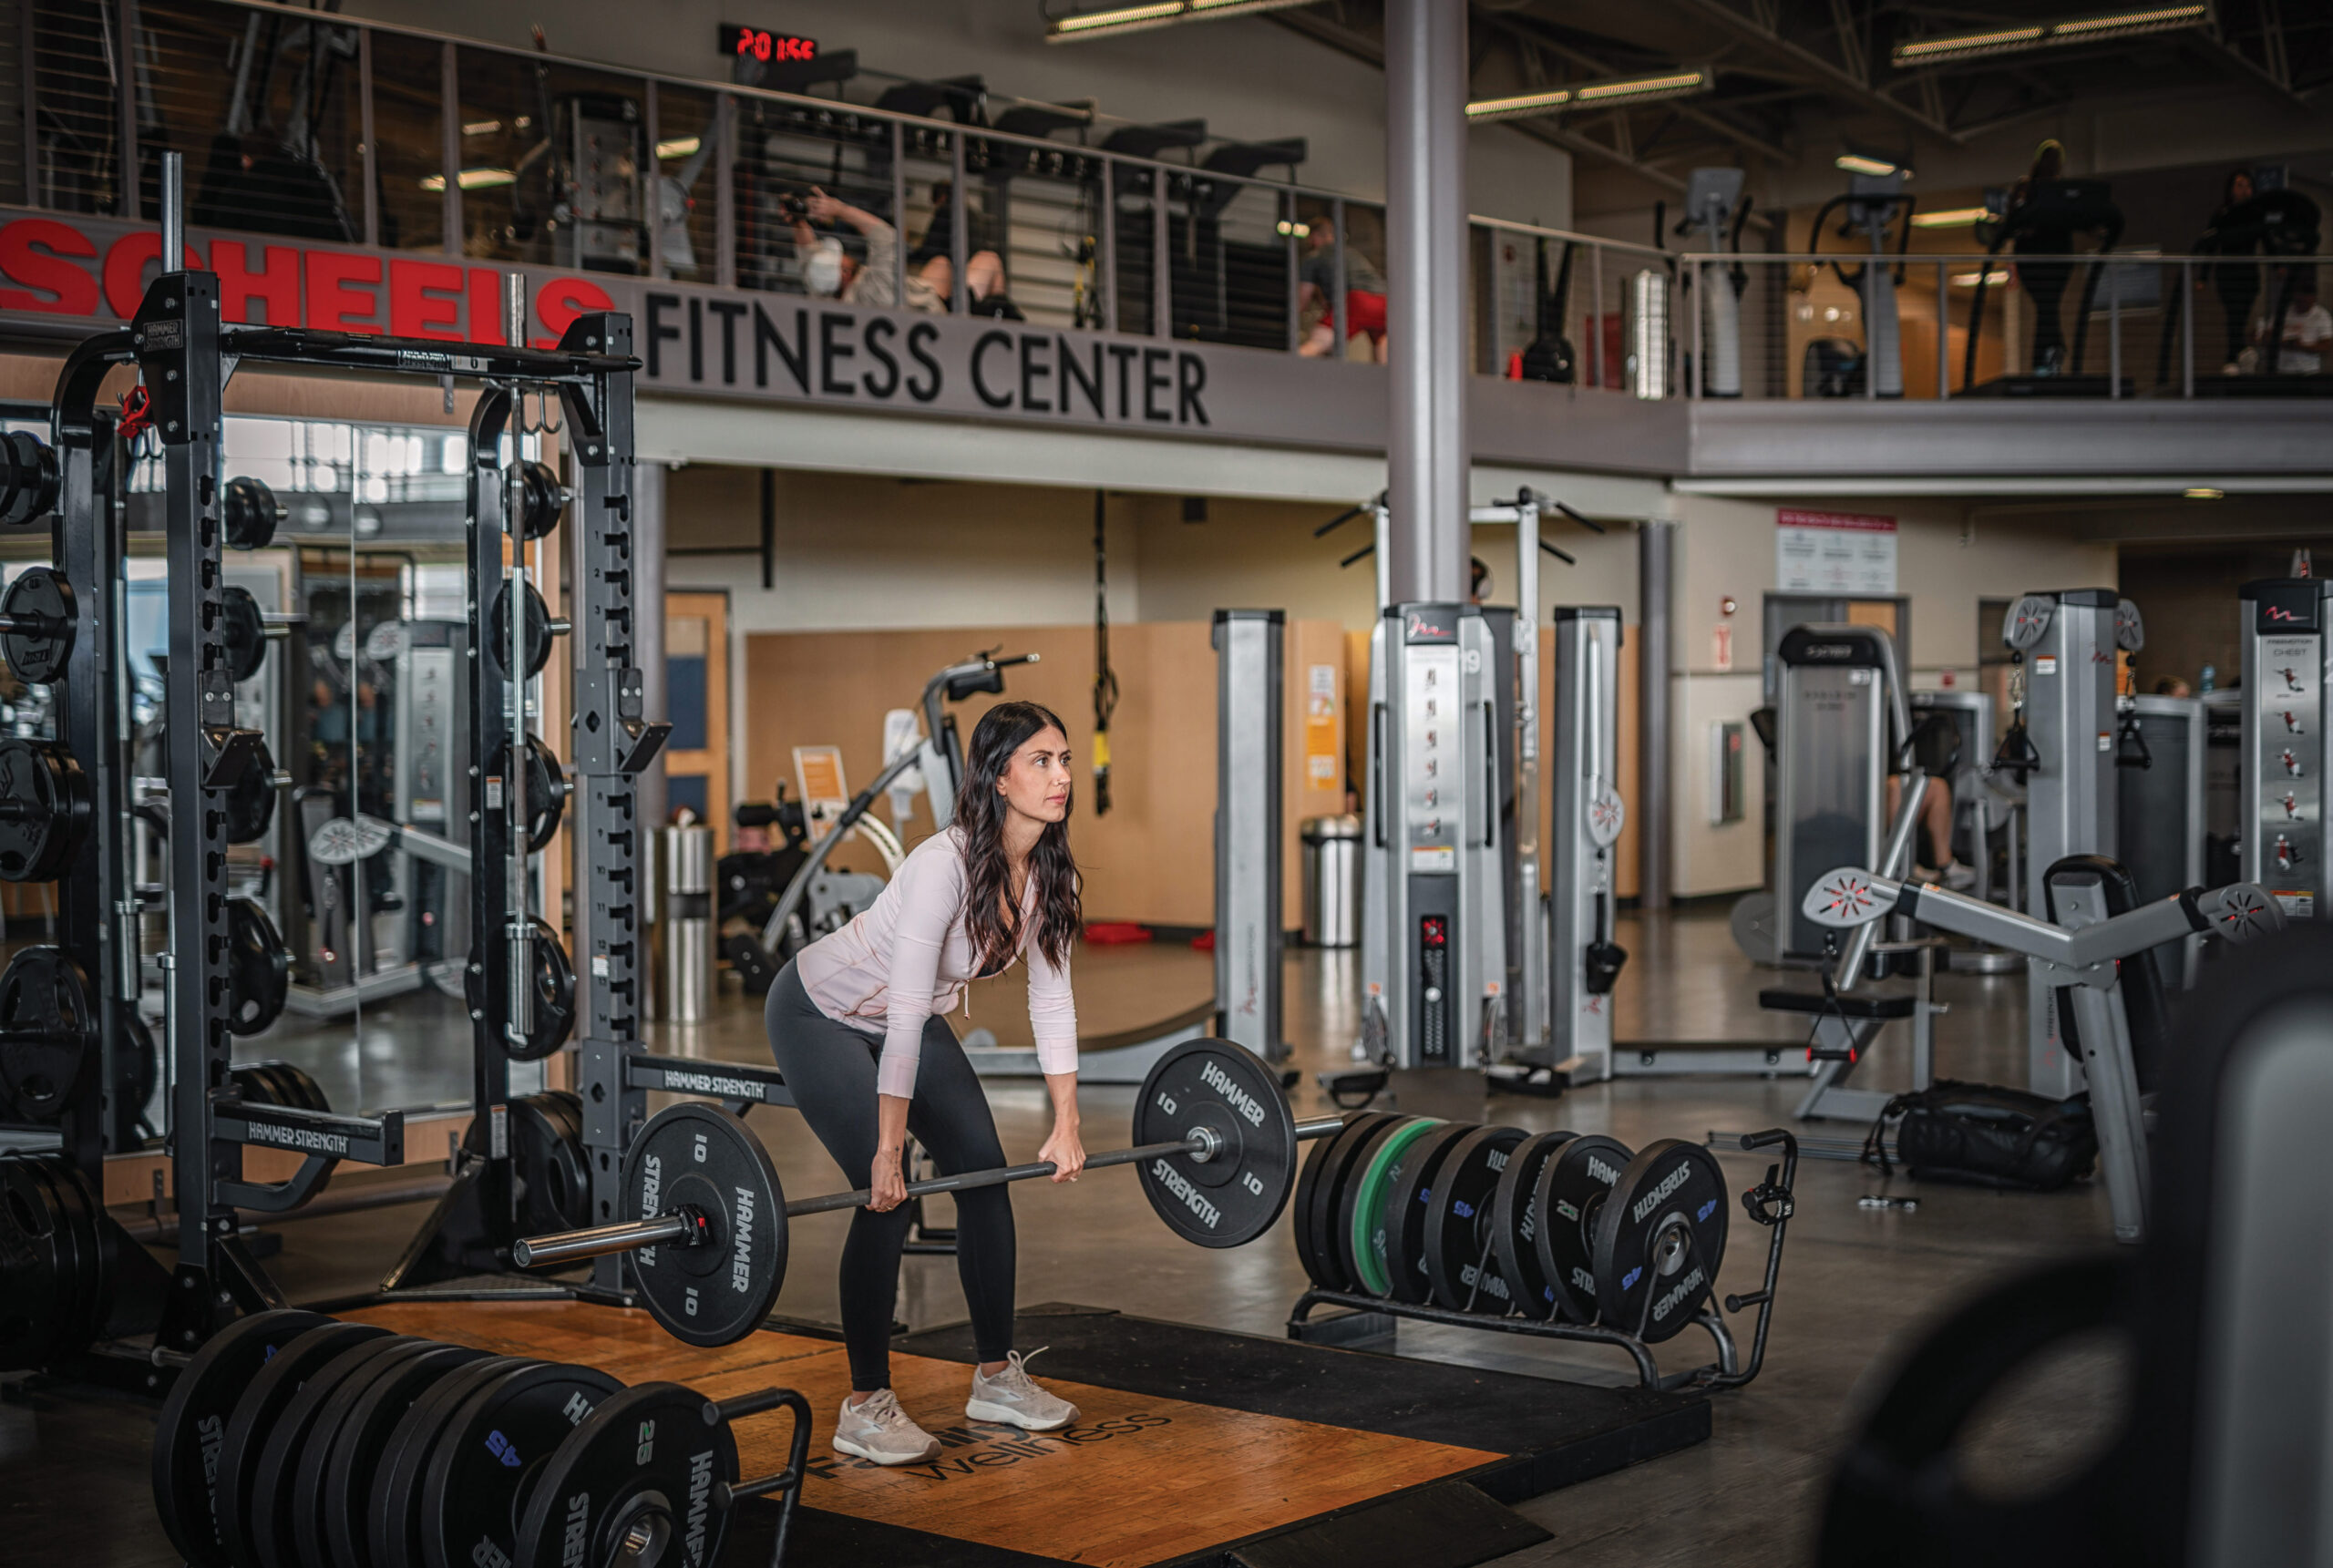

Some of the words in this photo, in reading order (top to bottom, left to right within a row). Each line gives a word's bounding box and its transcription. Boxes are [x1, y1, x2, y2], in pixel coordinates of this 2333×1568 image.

[147, 322, 179, 336] HAMMER
[646, 292, 943, 402] FITNESS
[970, 329, 1211, 425] CENTER
[664, 1070, 711, 1091] HAMMER
[712, 1076, 765, 1099] STRENGTH
[1199, 1061, 1266, 1128] HAMMER
[1156, 1091, 1177, 1116] 10
[249, 1121, 294, 1144] HAMMER
[295, 1129, 348, 1153] STRENGTH
[694, 1133, 708, 1163] 10
[1152, 1158, 1221, 1229] STRENGTH
[1242, 1171, 1264, 1195] 10
[1633, 1160, 1691, 1224] STRENGTH
[640, 1153, 661, 1267] STRENH
[1454, 1200, 1475, 1218] 45
[1557, 1199, 1579, 1222] 25
[1697, 1198, 1718, 1223] 45
[732, 1185, 755, 1294] HAMMER
[1621, 1266, 1642, 1291] 45
[1652, 1267, 1704, 1321] HAMMER
[684, 1286, 699, 1317] 10
[485, 1430, 522, 1467] 45
[636, 1419, 656, 1466] 25
[904, 1413, 1173, 1481] wellness
[563, 1491, 591, 1568] STREN
